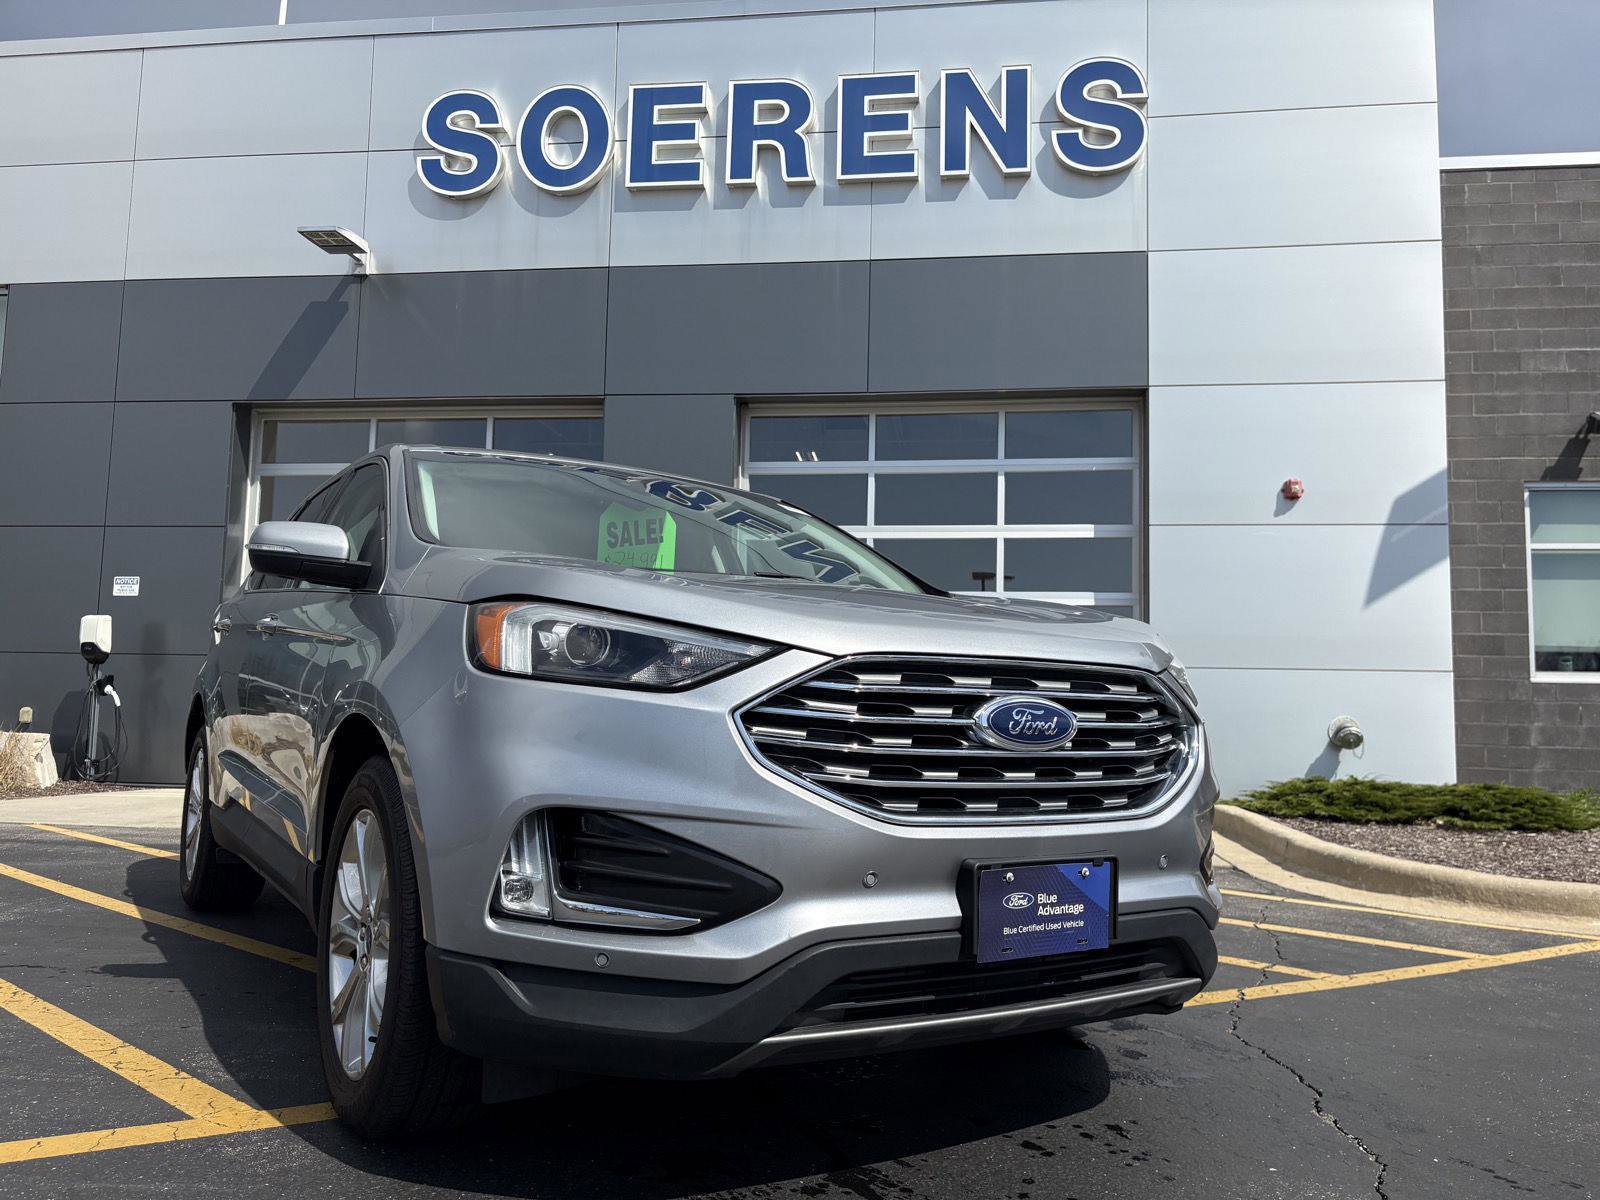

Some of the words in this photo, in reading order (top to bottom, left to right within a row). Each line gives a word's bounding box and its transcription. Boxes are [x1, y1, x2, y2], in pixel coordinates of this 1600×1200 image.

[416, 56, 1148, 198] SOERENS
[606, 517, 664, 549] SALE!
[1008, 708, 1058, 735] Ford
[1008, 894, 1028, 906] Ford
[1037, 893, 1057, 904] Blue
[1037, 903, 1084, 916] Advantage
[1003, 927, 1017, 935] Blue
[1018, 922, 1045, 933] Certified
[1045, 921, 1062, 930] Used
[1062, 919, 1085, 928] Vehicle
